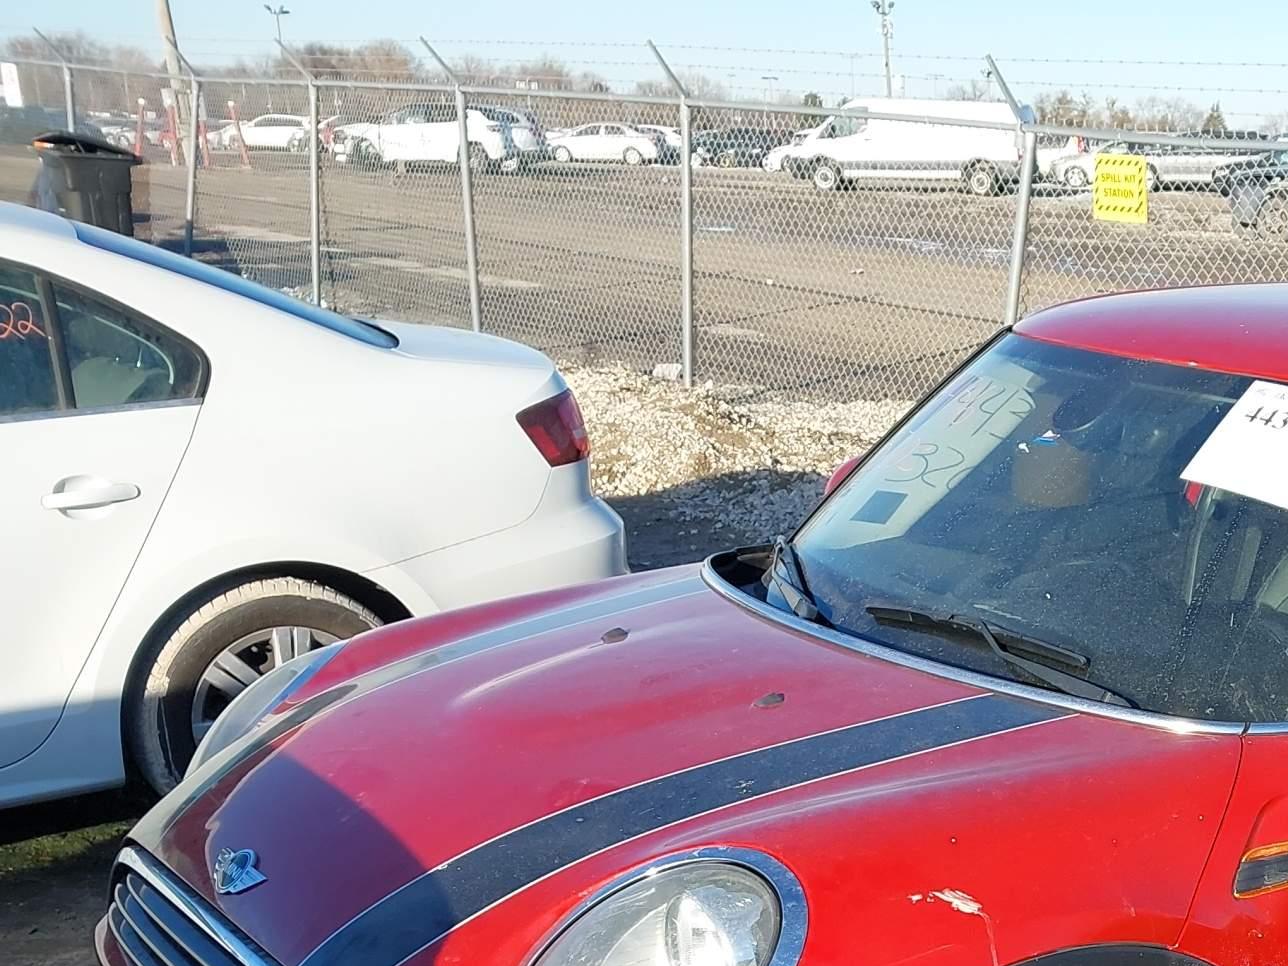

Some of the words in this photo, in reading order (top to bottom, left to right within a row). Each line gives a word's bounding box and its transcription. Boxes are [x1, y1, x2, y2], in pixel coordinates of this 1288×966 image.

[1101, 173, 1121, 183] SPILL
[1124, 174, 1137, 184] KIT
[1103, 188, 1134, 198] STATION
